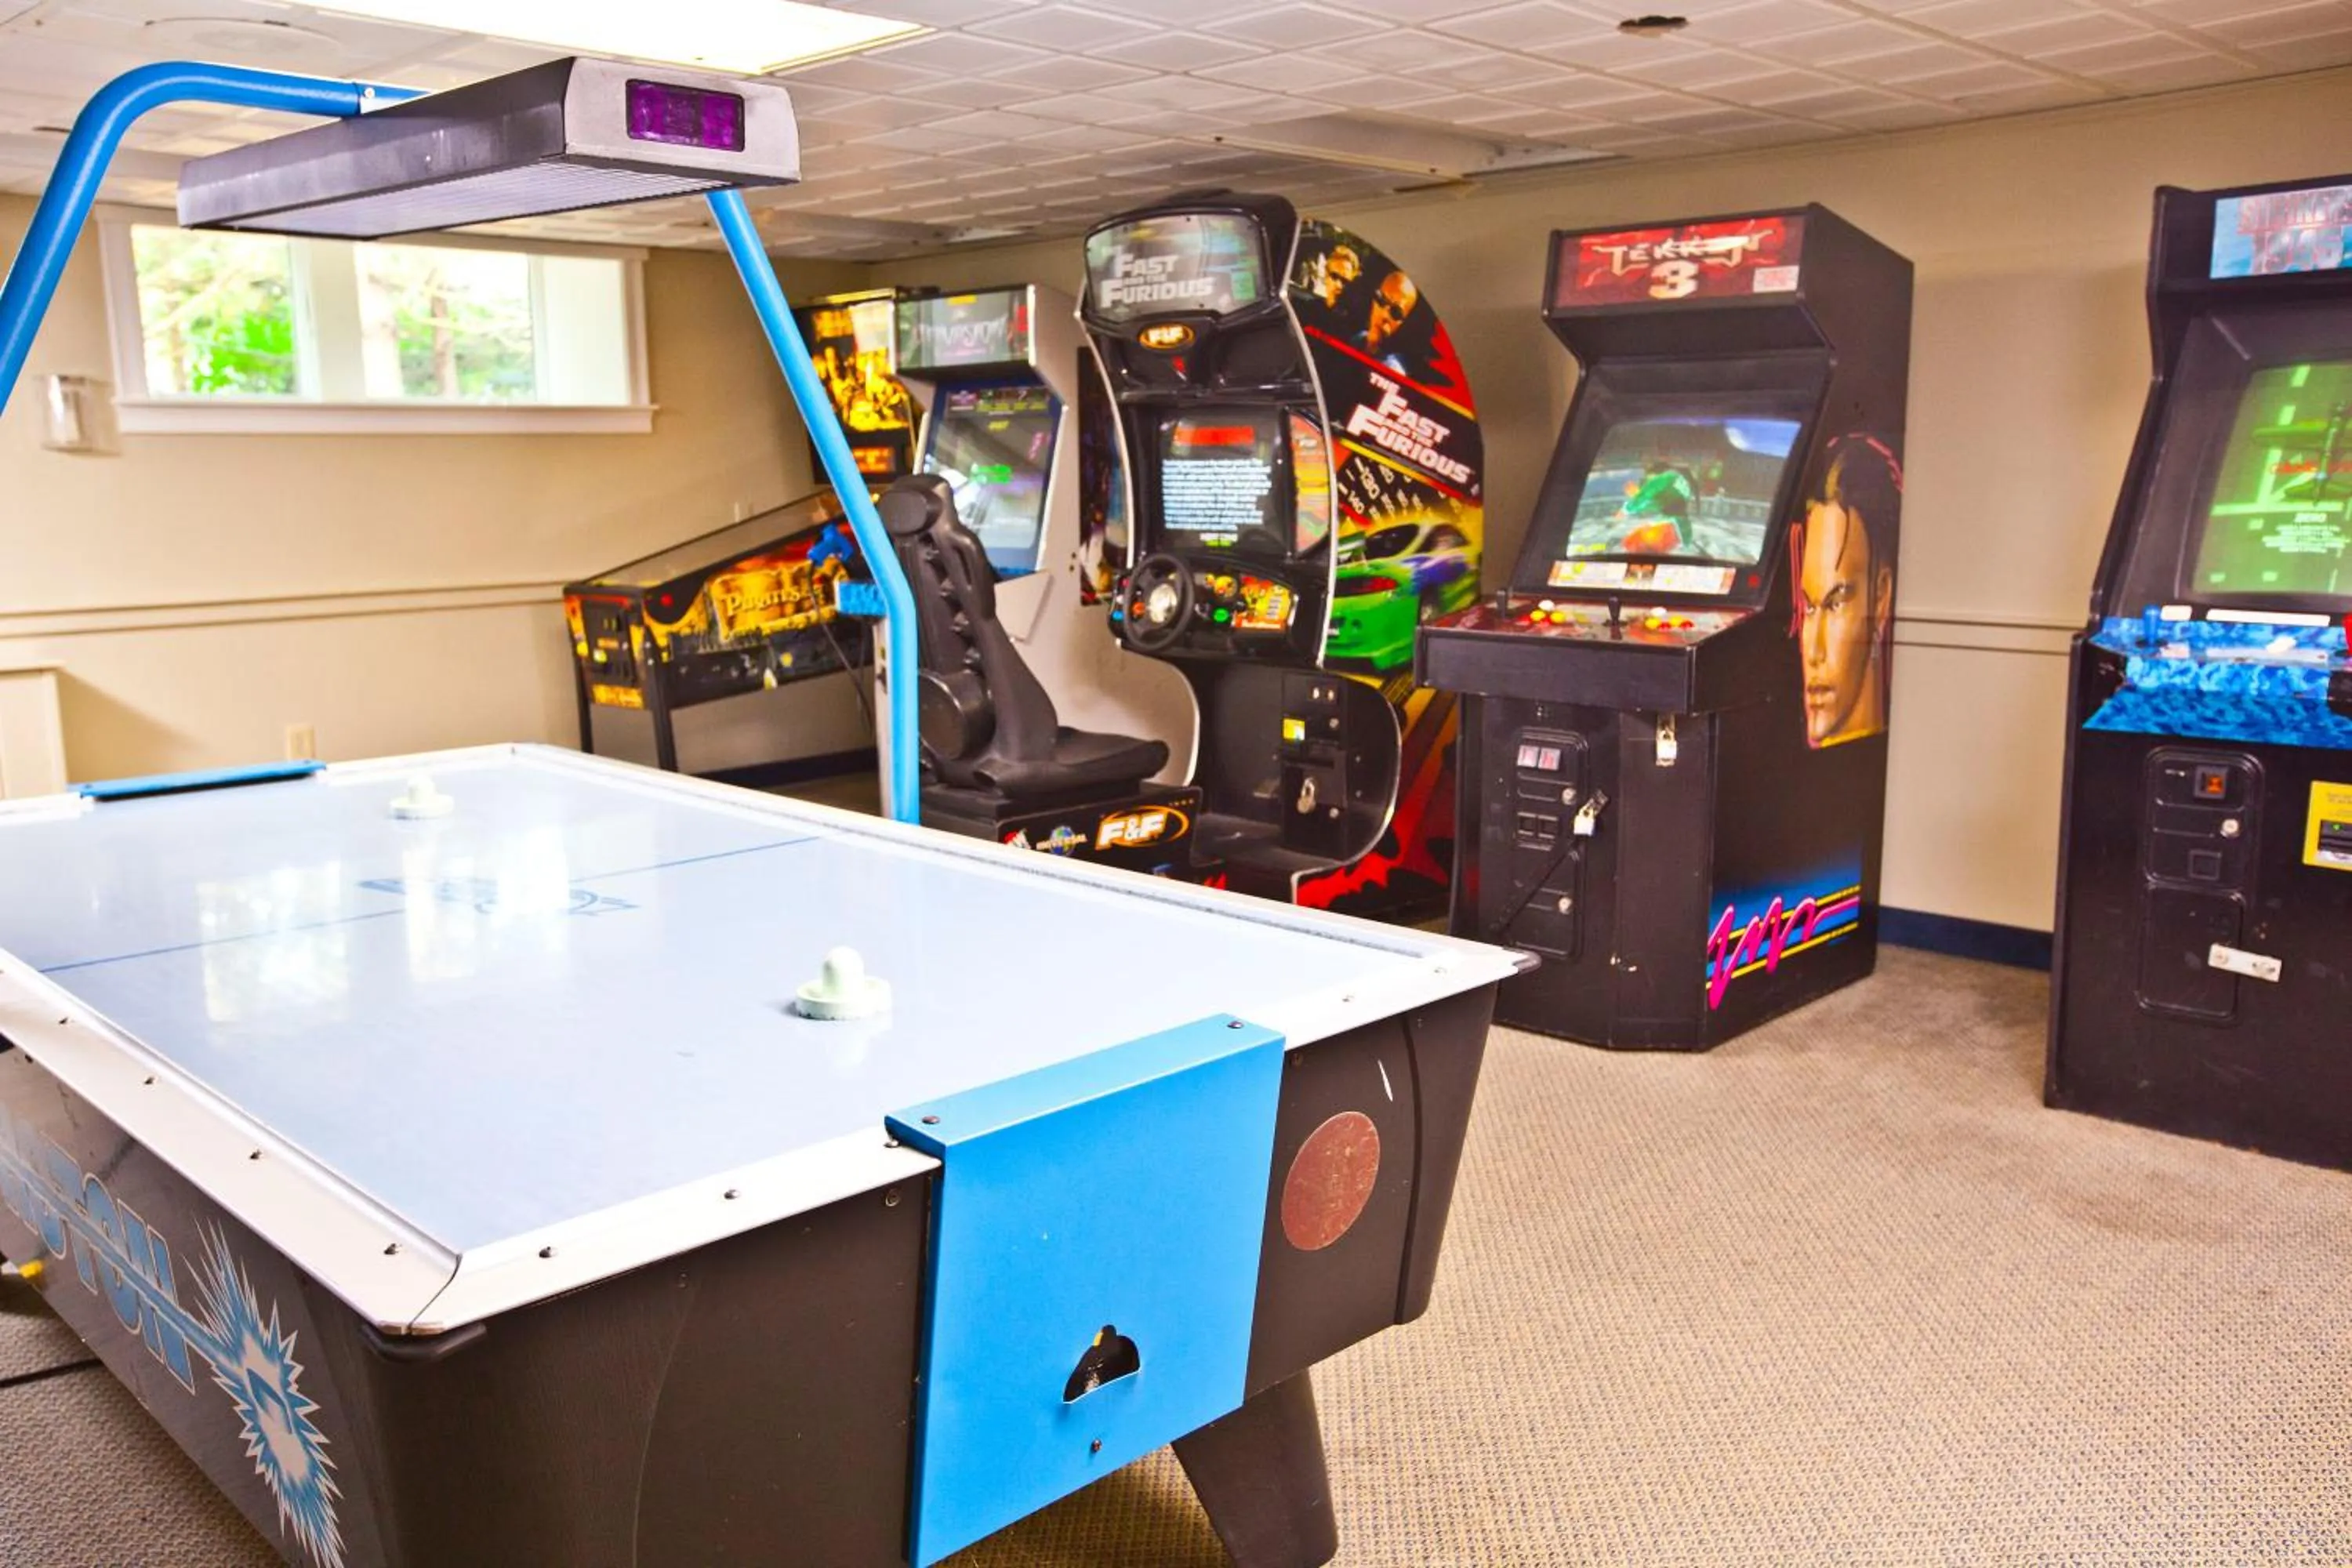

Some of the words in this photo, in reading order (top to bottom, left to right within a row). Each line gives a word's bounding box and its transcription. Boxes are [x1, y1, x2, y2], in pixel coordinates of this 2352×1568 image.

[1114, 252, 1179, 278] FAST
[1649, 260, 1699, 299] 3
[1100, 277, 1216, 308] FURIOUS
[1377, 390, 1451, 444] FAST
[1346, 403, 1472, 485] FURIOUS
[1097, 811, 1166, 850] F&F
